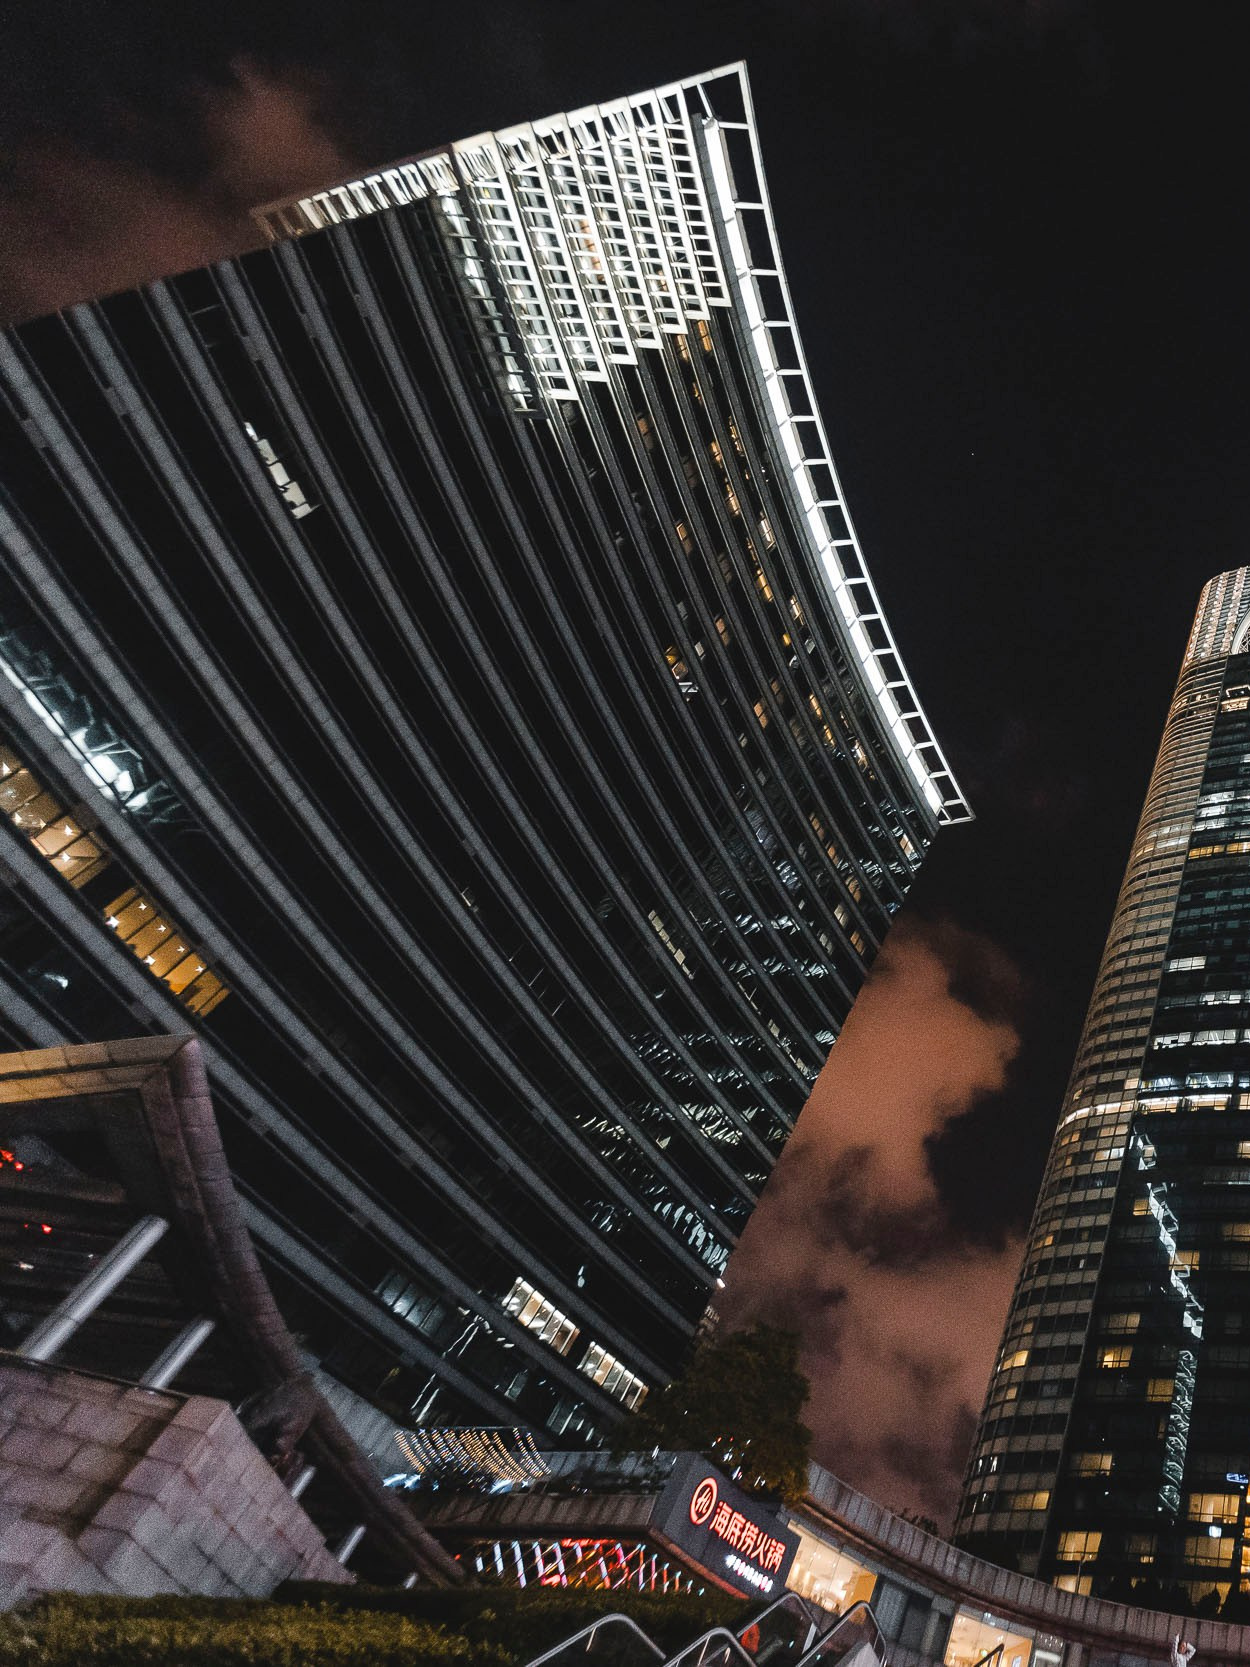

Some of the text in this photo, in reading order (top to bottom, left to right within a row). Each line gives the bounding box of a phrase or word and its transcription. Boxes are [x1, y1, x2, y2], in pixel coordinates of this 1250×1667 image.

[709, 1500, 786, 1574] 海底捞火锅
